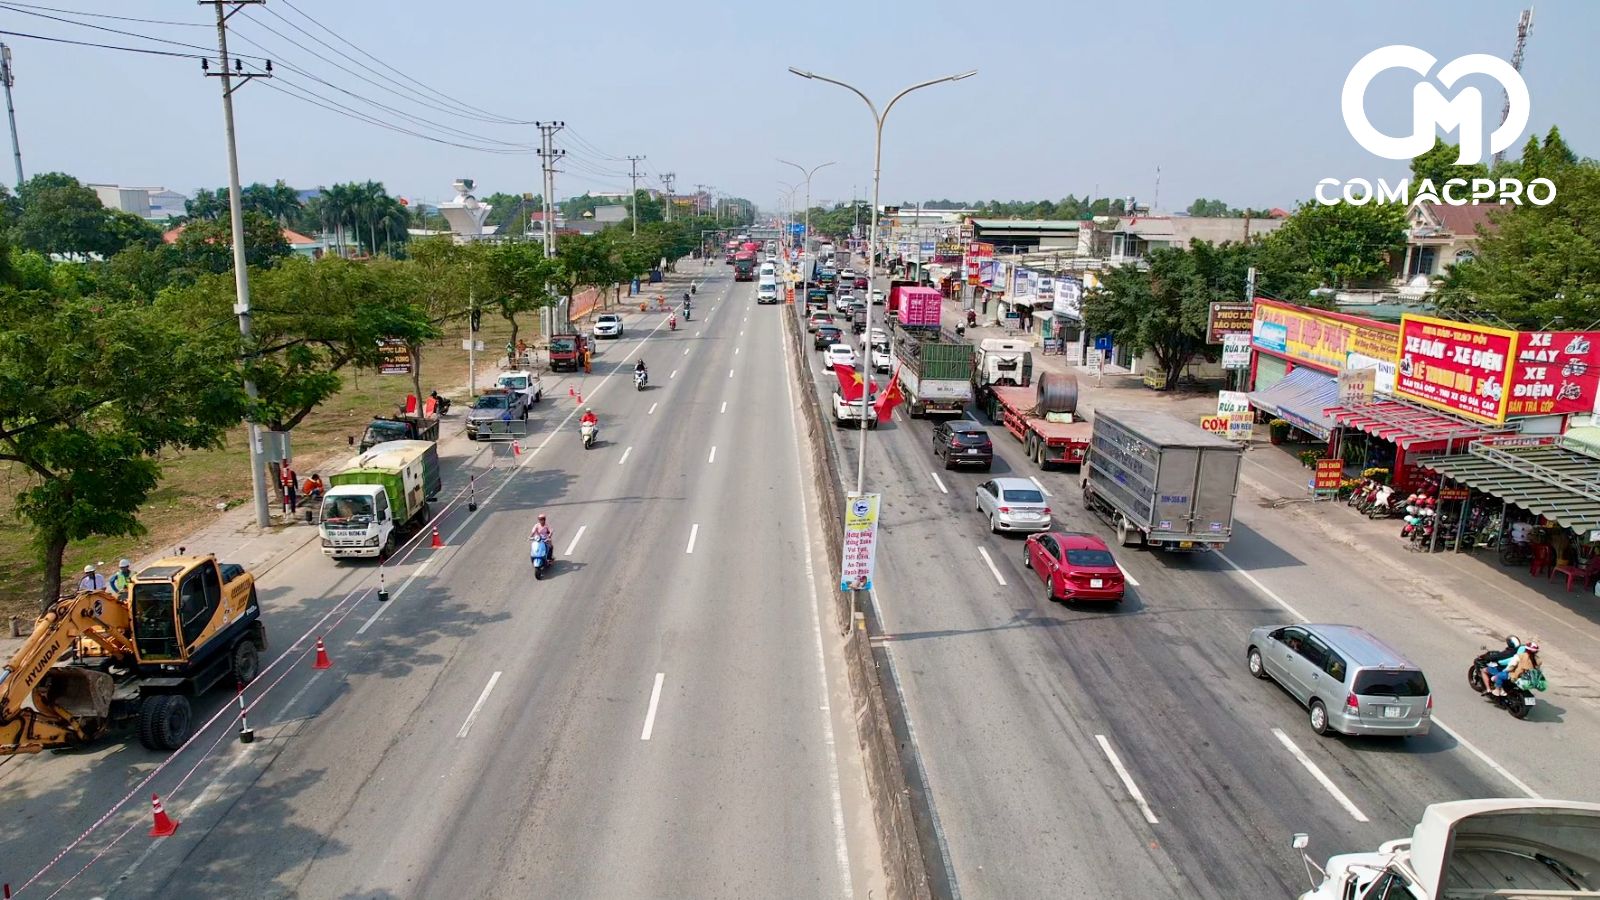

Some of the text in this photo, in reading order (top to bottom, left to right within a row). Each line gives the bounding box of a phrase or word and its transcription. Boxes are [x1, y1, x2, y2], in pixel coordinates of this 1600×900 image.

[1528, 333, 1552, 346] XE
[1240, 345, 1250, 353] XE
[1405, 335, 1421, 353] XE
[1420, 339, 1447, 359] MÁY
[1453, 345, 1473, 365] XE
[1472, 349, 1504, 374] ĐIỆN
[1519, 347, 1560, 363] MÁY
[1413, 360, 1425, 380] LÊ
[1523, 367, 1547, 380] XE
[1402, 377, 1413, 387] BÁN
[1424, 383, 1436, 393] GÓP
[1450, 391, 1459, 400] XE
[1481, 399, 1496, 411] CAO
[1513, 381, 1554, 399] ĐIỆN
[1508, 400, 1523, 412] BÁN
[1525, 400, 1538, 412] TRẢ
[1540, 400, 1554, 412] GÓP
[1201, 417, 1228, 431] CƠM
[25, 640, 61, 687] HYUNDAI
